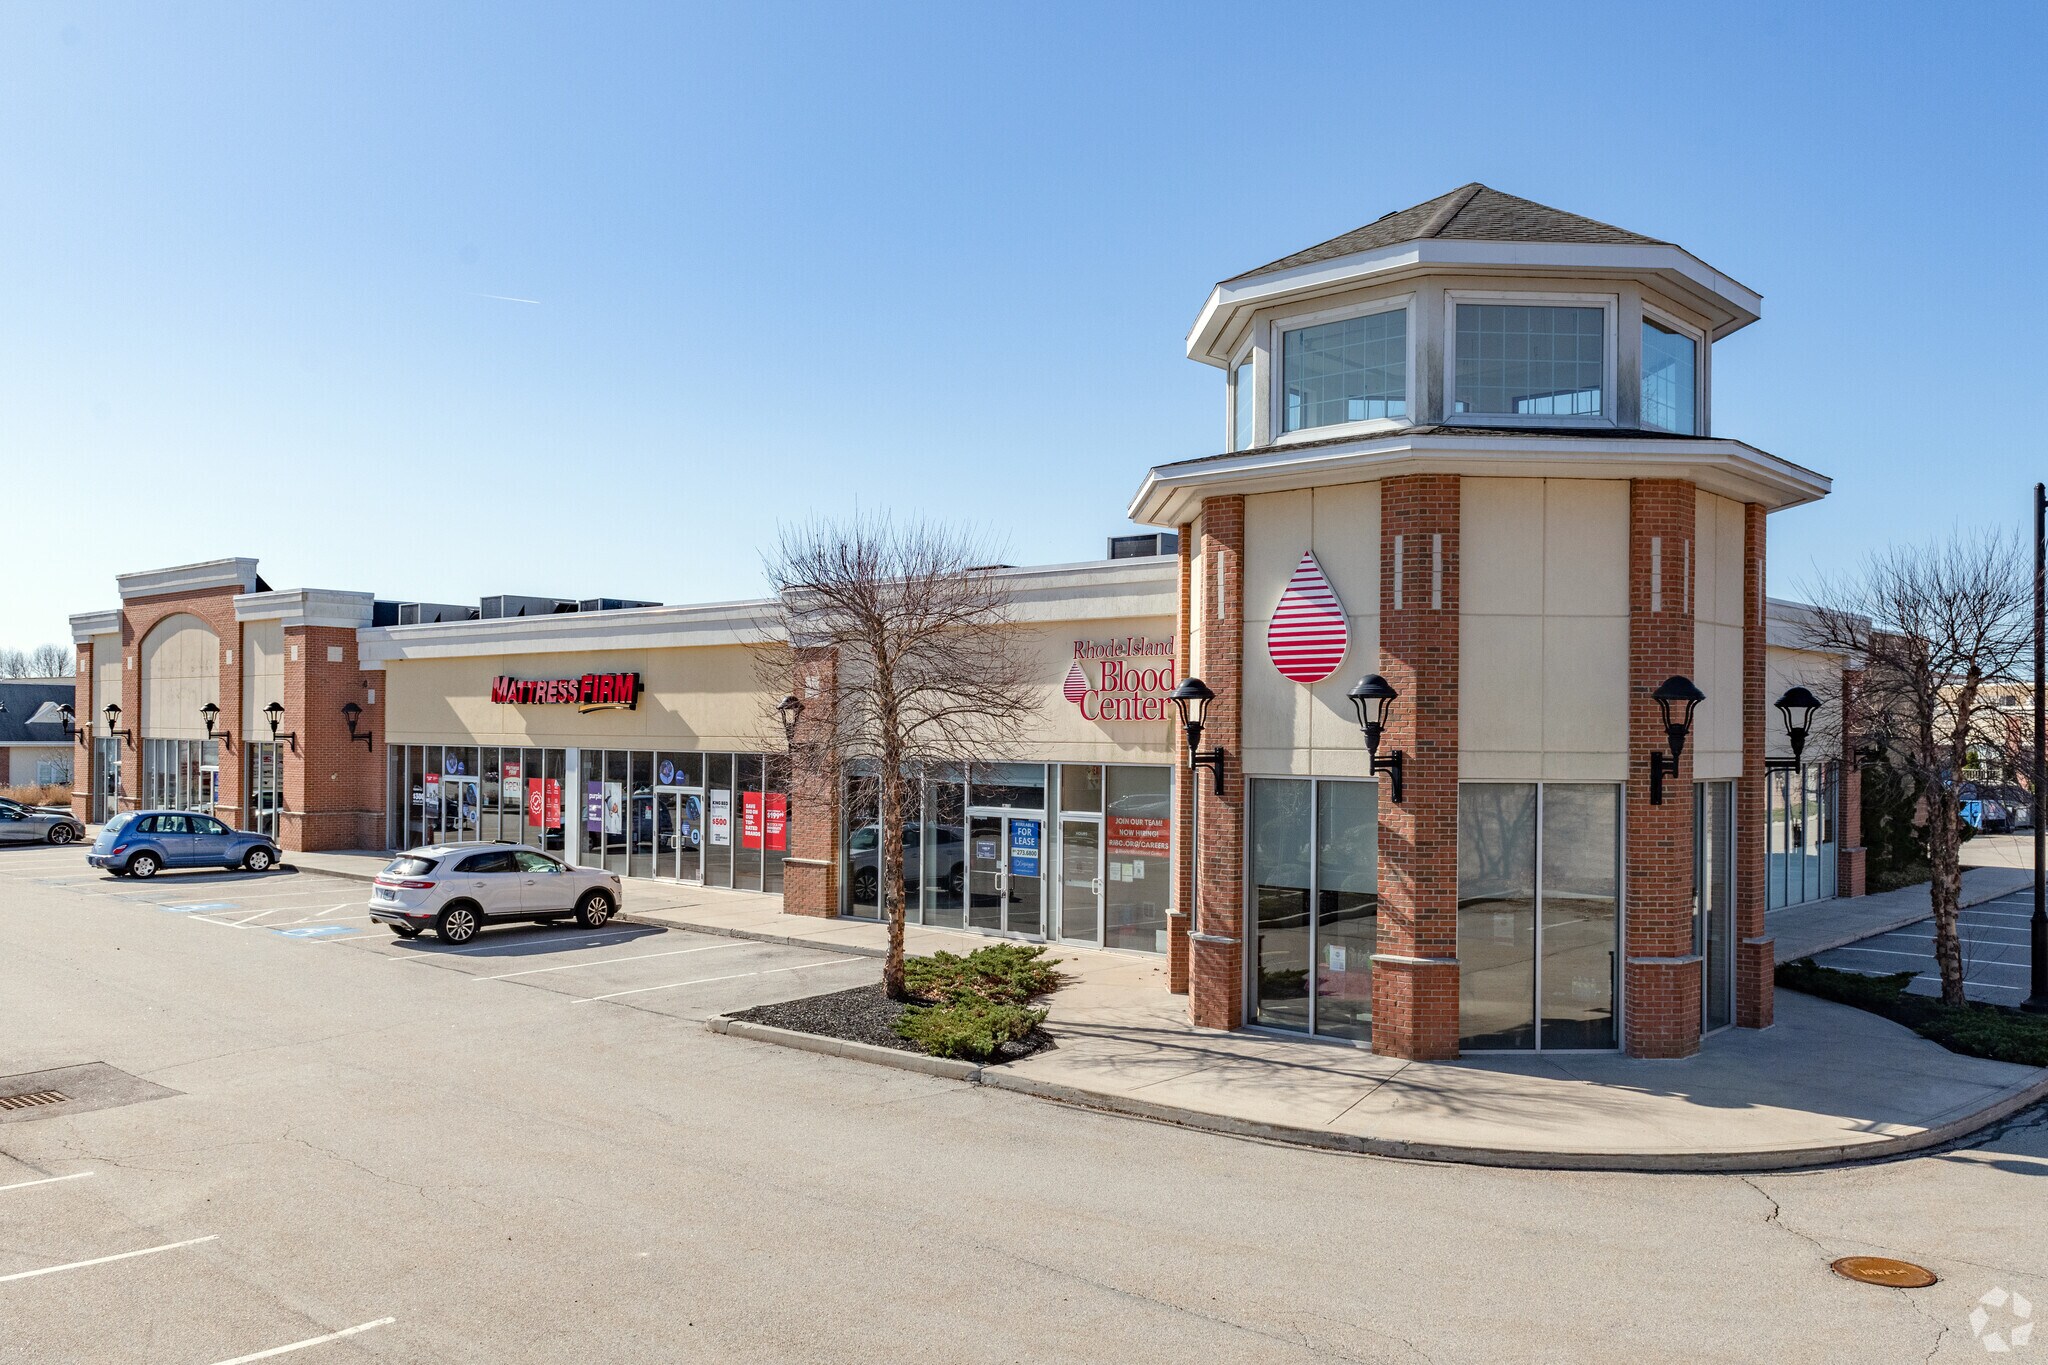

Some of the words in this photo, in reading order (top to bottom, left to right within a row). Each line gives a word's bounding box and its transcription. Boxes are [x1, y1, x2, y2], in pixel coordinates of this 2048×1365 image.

[1073, 639, 1123, 660] Rhode
[1127, 635, 1175, 656] Island
[1100, 659, 1176, 692] Blood
[579, 673, 637, 704] FIRM
[1080, 689, 1172, 721] Center
[1116, 817, 1129, 825] JOIN
[1130, 818, 1144, 826] OUR
[1145, 819, 1163, 827] TEAM!
[1017, 827, 1032, 837] FOR
[1119, 829, 1135, 837] NOW
[1014, 837, 1035, 846] LEASE
